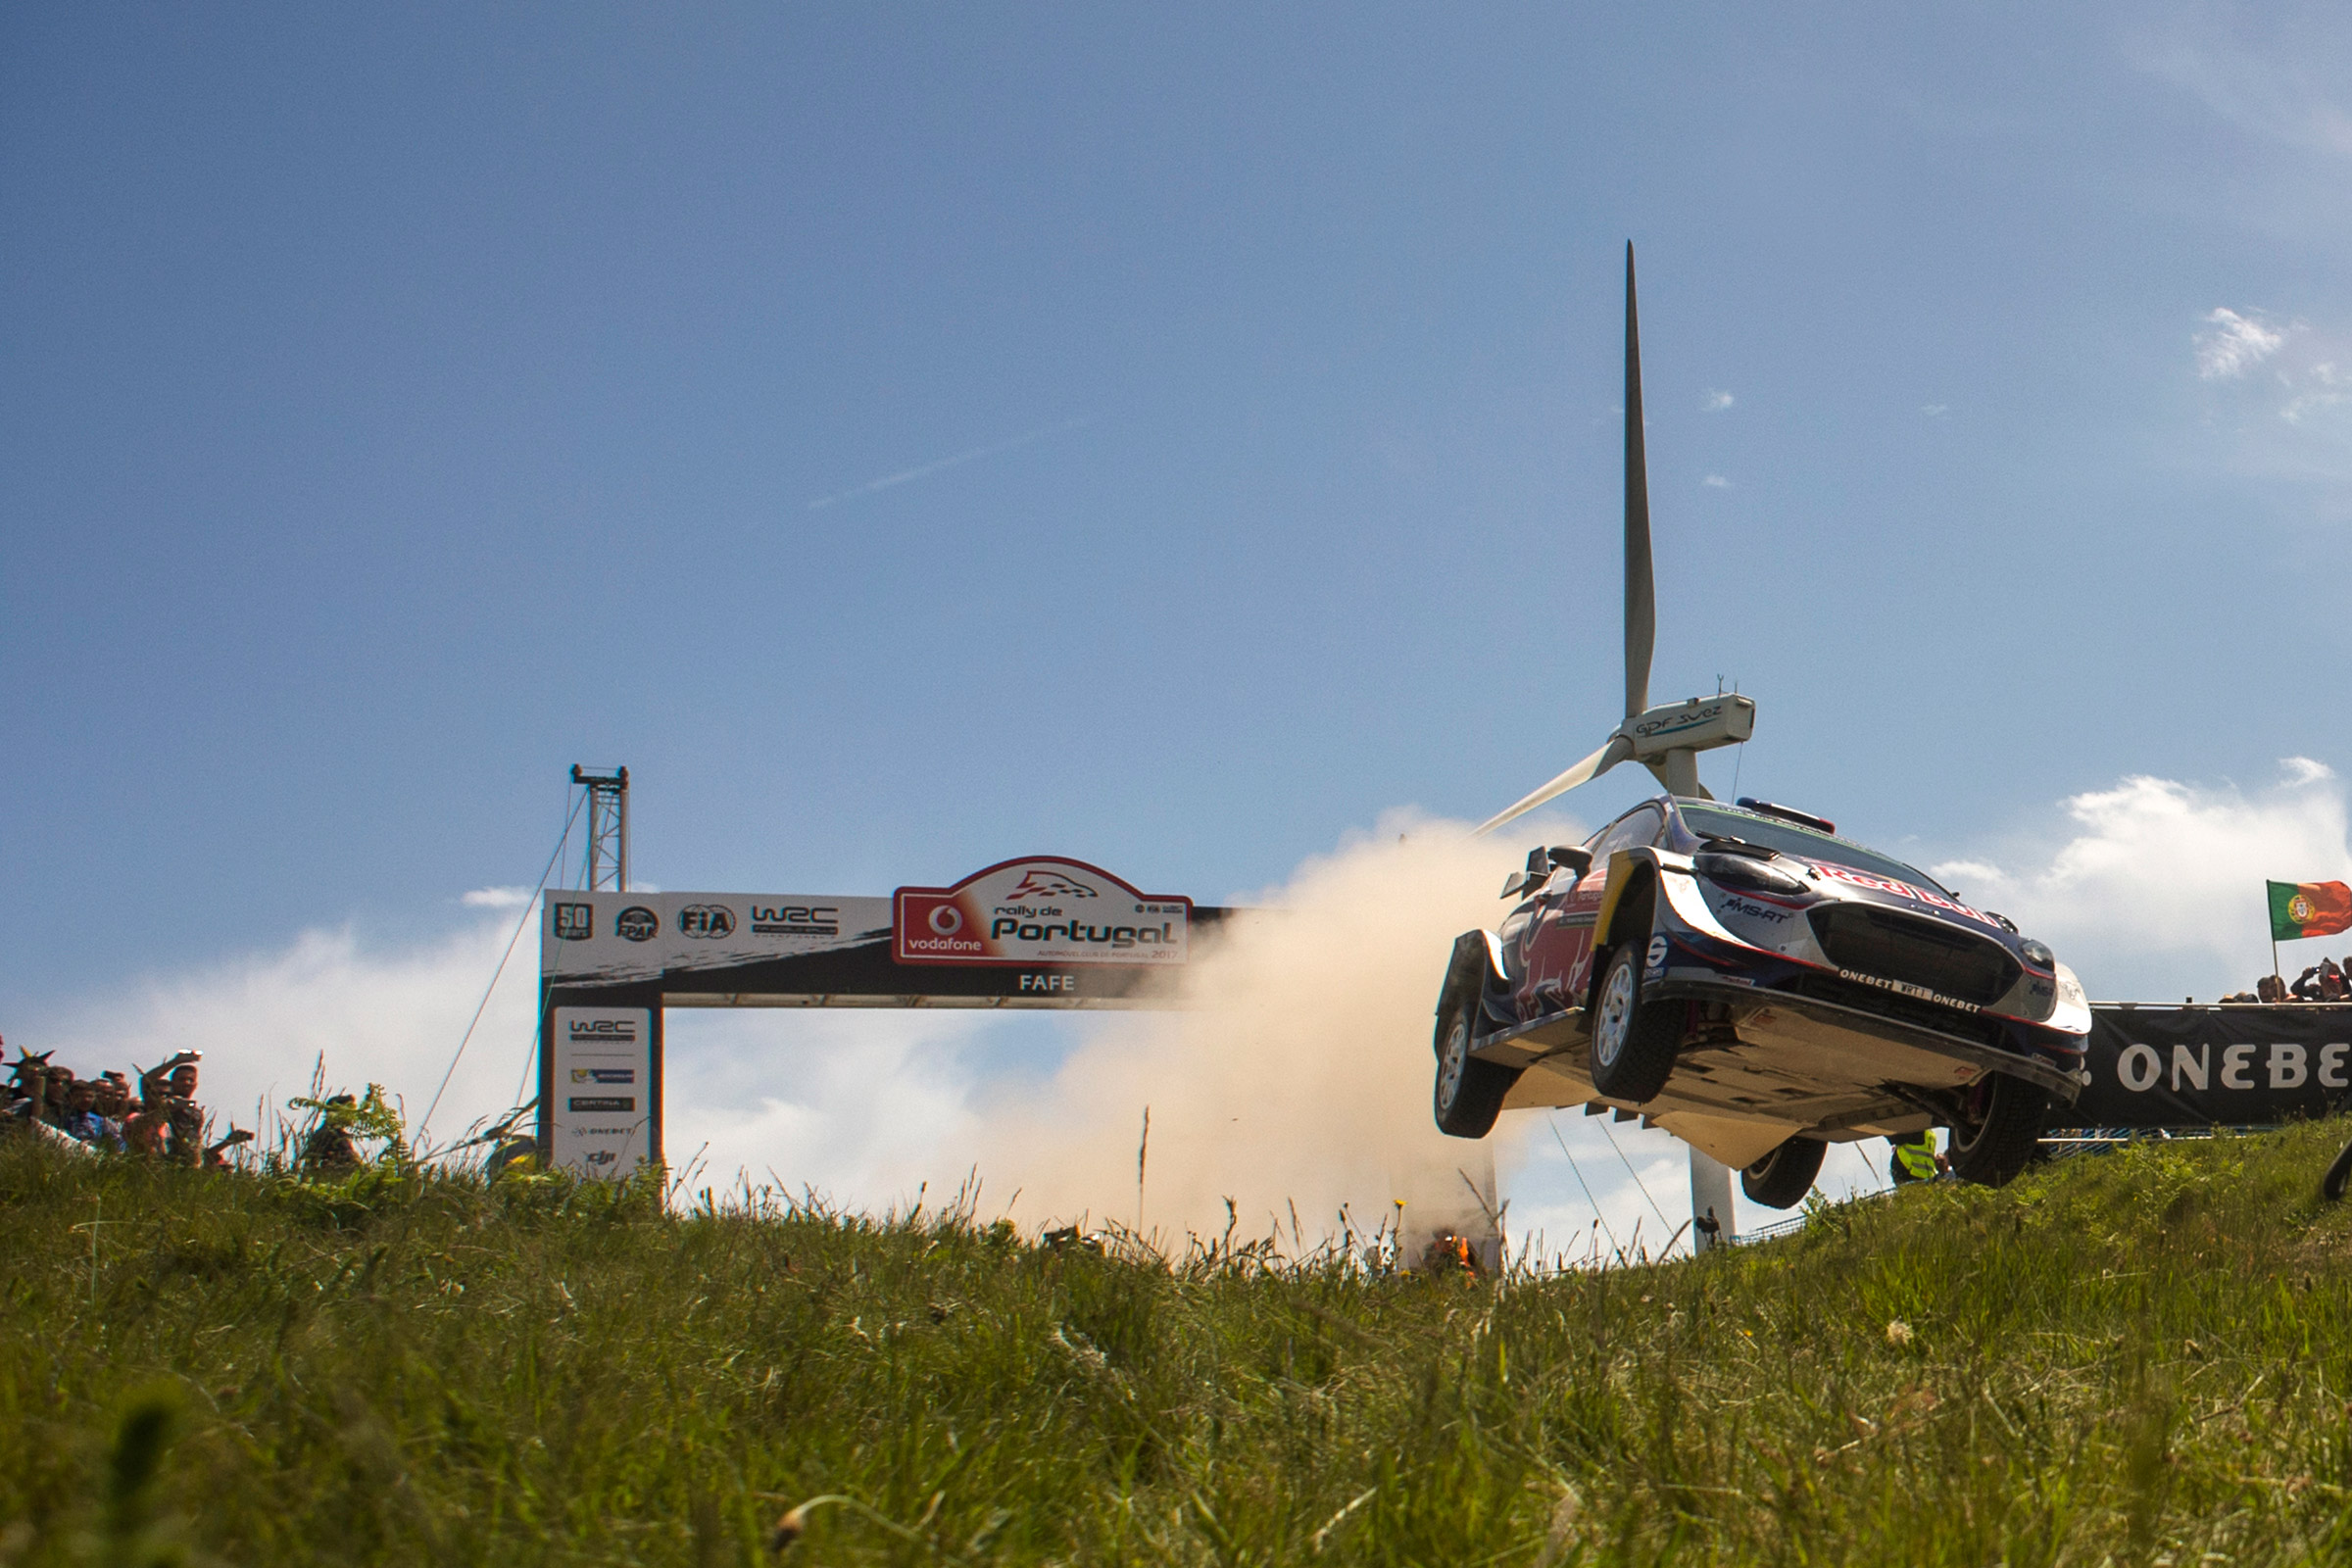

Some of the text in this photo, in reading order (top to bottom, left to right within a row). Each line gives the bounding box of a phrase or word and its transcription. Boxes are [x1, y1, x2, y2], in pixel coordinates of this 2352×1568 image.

[1812, 863, 2002, 930] Red Bull
[752, 906, 839, 923] WRC
[994, 906, 1063, 918] rally de
[991, 917, 1177, 949] Portugal
[908, 937, 982, 951] vodafone
[1020, 974, 1075, 991] FAFE
[1839, 968, 1892, 989] ONEBET
[1933, 993, 1982, 1013] ONEBET
[570, 1020, 635, 1032] WRC
[2117, 1043, 2351, 1092] ONEBE
